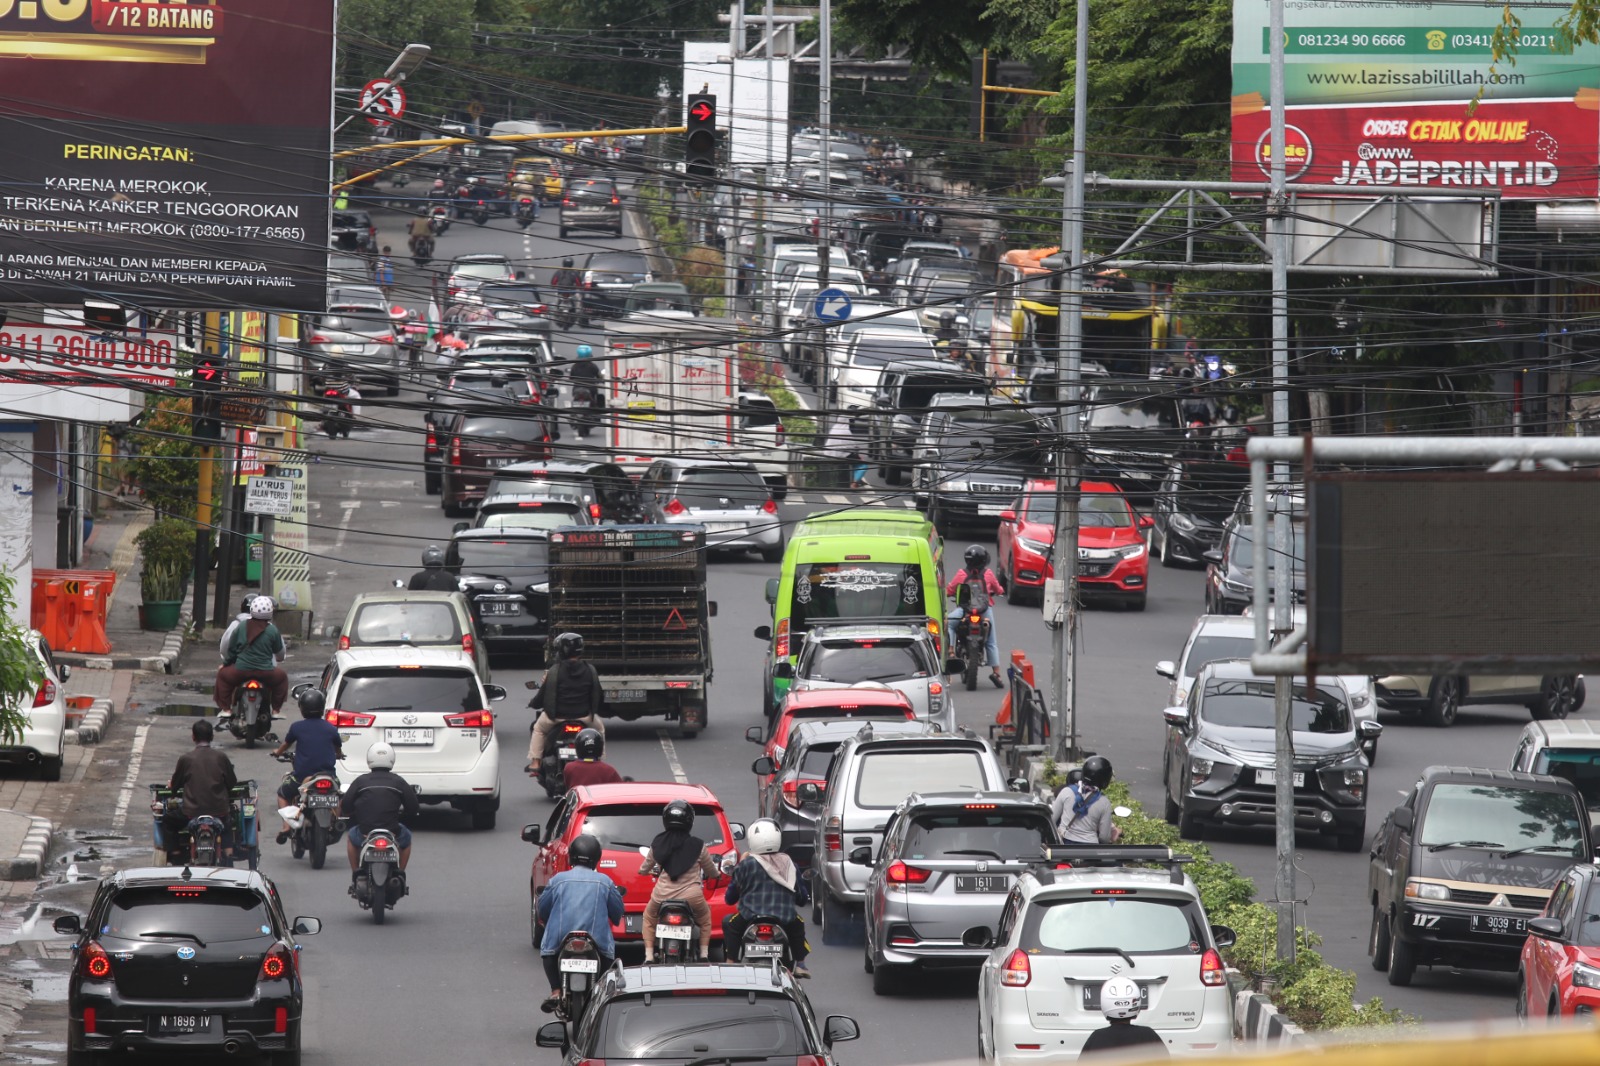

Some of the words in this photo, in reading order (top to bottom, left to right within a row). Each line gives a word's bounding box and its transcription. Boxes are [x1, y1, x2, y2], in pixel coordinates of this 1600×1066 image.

[107, 6, 141, 27] /12
[147, 7, 214, 30] BATANG
[1298, 34, 1348, 46] 081234
[1351, 34, 1369, 46] 90
[1372, 34, 1406, 46] 6666
[1307, 69, 1525, 85] www.lazissabilillah.com
[1363, 119, 1408, 137] ORDER
[1410, 120, 1464, 141] CETAK
[1465, 120, 1529, 142] ONLINE
[64, 144, 194, 162] PERINGATAN:
[1261, 144, 1306, 157] Jde
[1369, 148, 1413, 160] www.
[1332, 160, 1558, 186] JADEPRINT.ID
[45, 177, 116, 192] KARENA
[120, 180, 211, 197] MEROKOK,
[3, 196, 85, 212] TERKENA
[88, 199, 159, 215] KANKER
[164, 201, 299, 218] TENGGOROKAN
[24, 220, 101, 233] BERHENTI
[107, 222, 185, 236] MEROKOK
[190, 223, 305, 241] (0800-177-6565)
[57, 256, 117, 267] MENJUAL
[121, 257, 148, 268] DAN
[152, 258, 212, 270] MEMBERI
[215, 260, 267, 272] KEPADA
[75, 271, 88, 281] 21
[93, 271, 136, 282] TAHUN
[140, 272, 167, 283] DAN
[171, 273, 252, 286] PEREMPUAN
[256, 276, 296, 287] HAMIL
[53, 335, 117, 367] 3600
[124, 338, 171, 371] 800
[623, 367, 645, 379] J&T
[681, 367, 704, 378] J&T
[250, 489, 269, 498] JALAN
[270, 491, 288, 500] TERUS
[387, 730, 393, 738] N
[423, 731, 432, 739] AU
[957, 877, 964, 888] N
[975, 877, 992, 888] 1611
[626, 916, 633, 926] W
[1412, 913, 1441, 927] 117
[1472, 915, 1479, 926] N
[1487, 917, 1509, 929] 9039
[1084, 988, 1092, 999] N
[160, 1015, 167, 1027] N
[173, 1015, 195, 1027] 1896
[200, 1016, 210, 1027] IV
